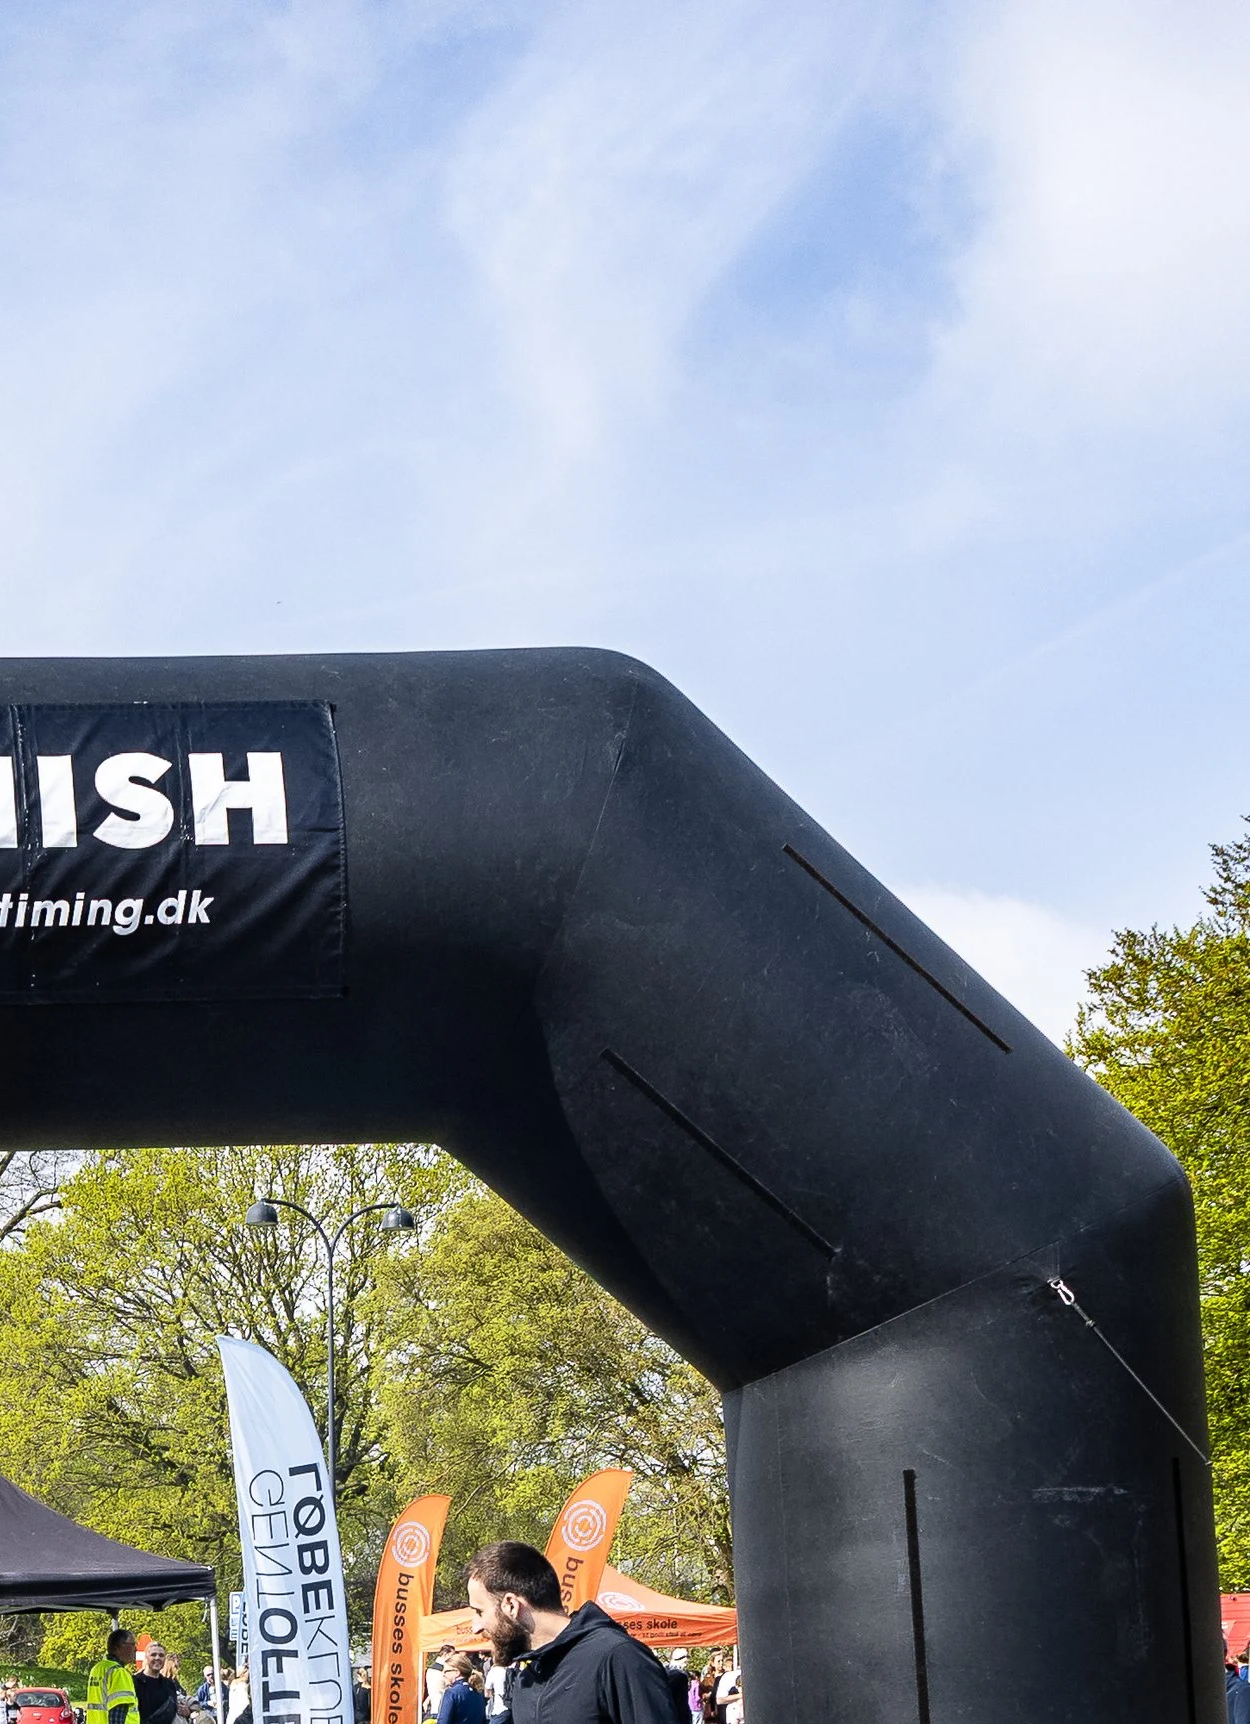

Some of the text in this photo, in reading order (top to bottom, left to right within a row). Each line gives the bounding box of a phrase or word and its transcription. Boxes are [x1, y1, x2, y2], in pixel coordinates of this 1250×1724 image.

[388, 1572, 414, 1724] busses skole
[647, 1618, 678, 1630] skole
